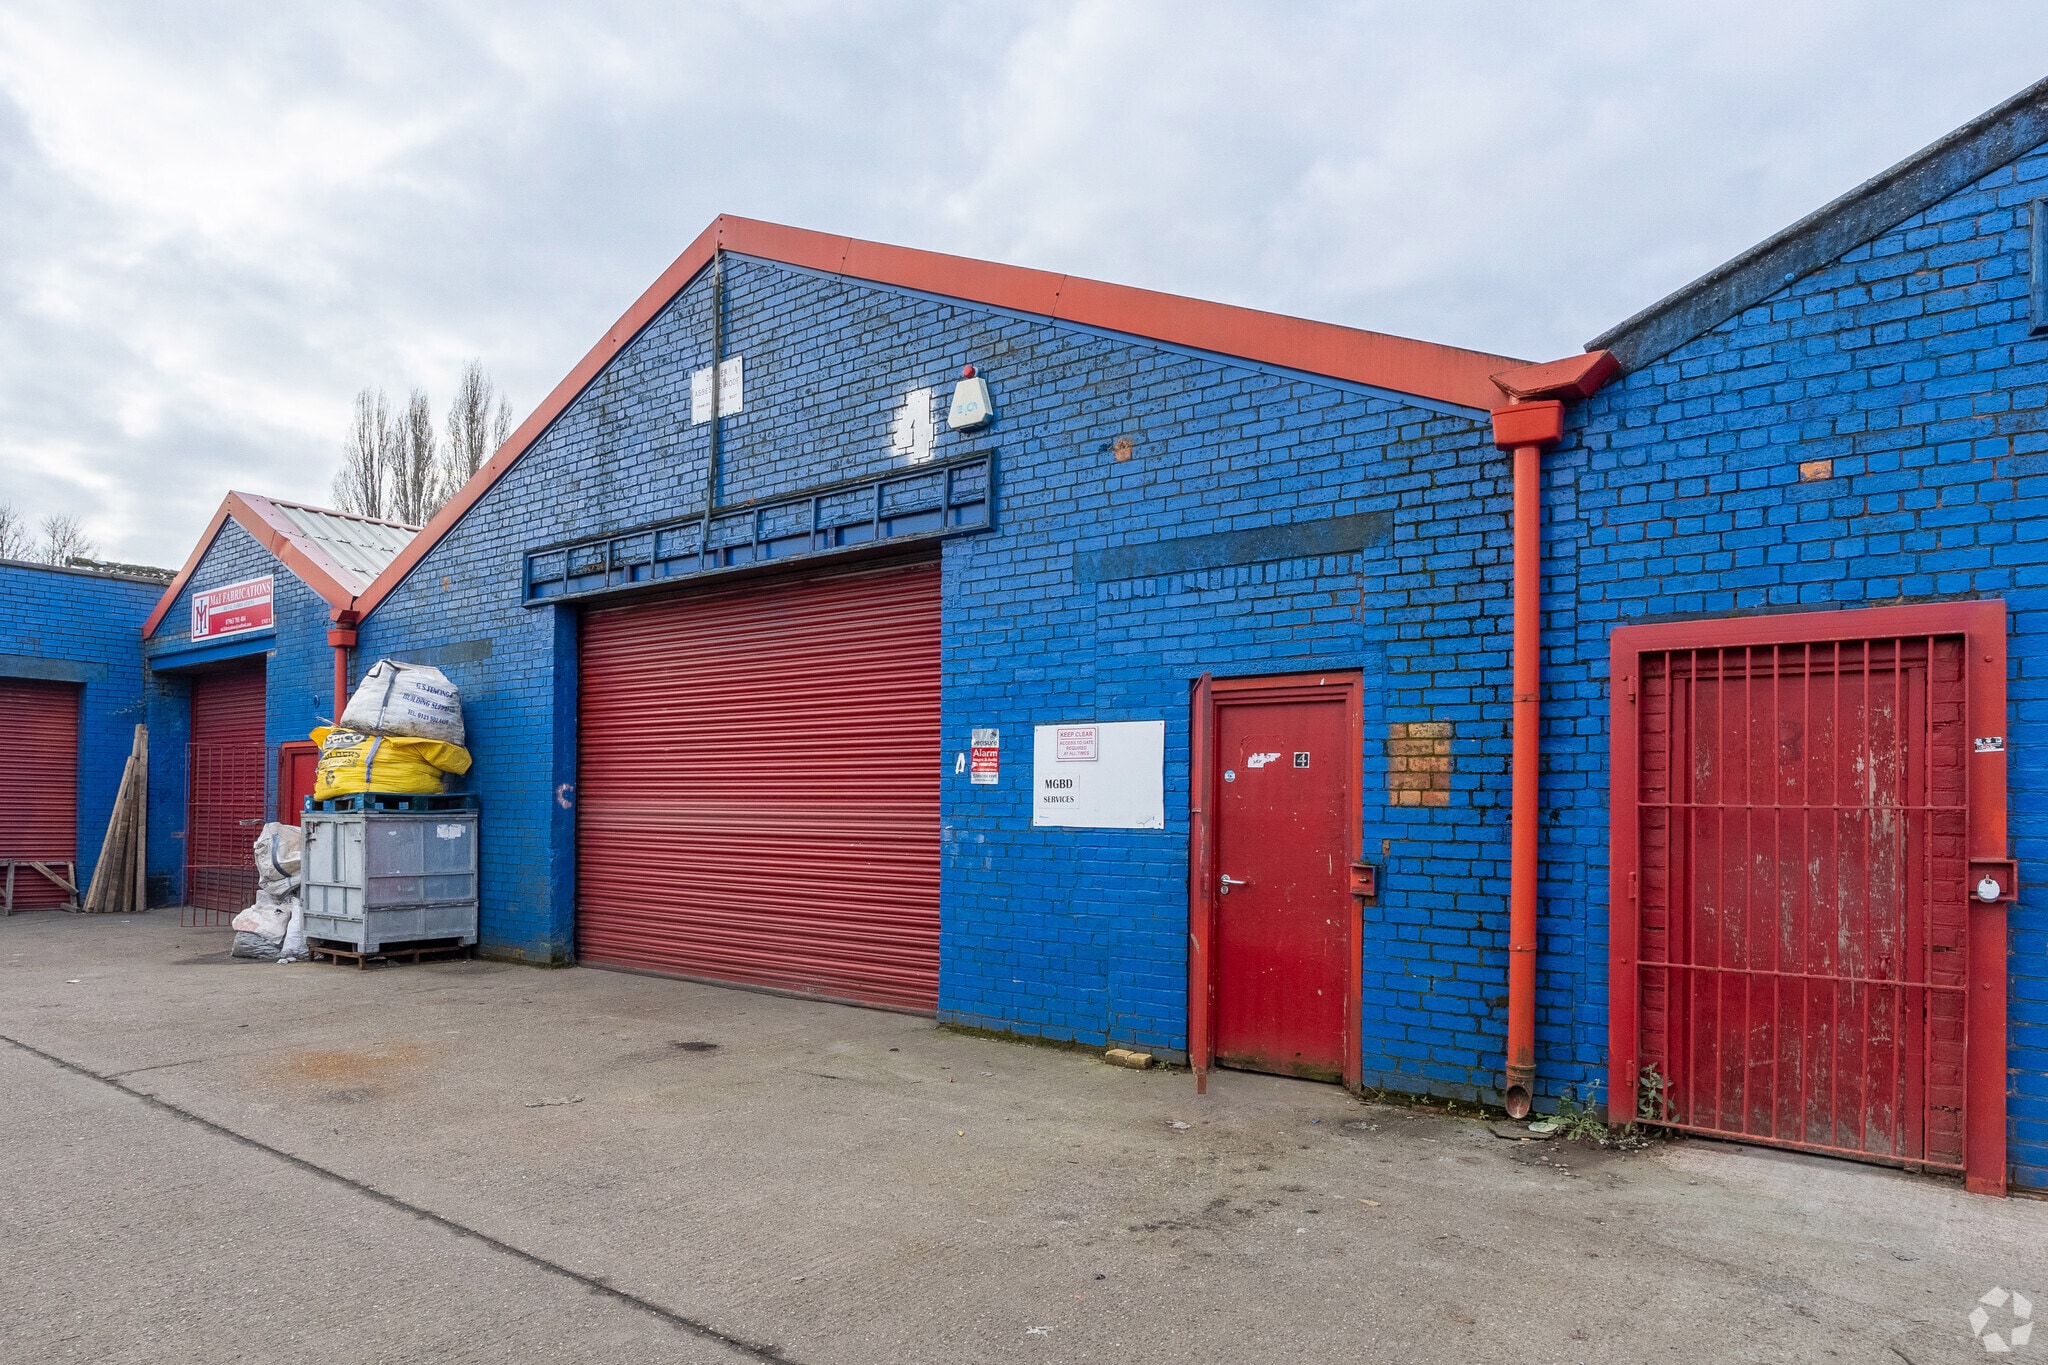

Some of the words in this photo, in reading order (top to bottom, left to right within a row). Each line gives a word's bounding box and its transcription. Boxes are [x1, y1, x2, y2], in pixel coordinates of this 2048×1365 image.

[890, 385, 933, 465] 4
[222, 582, 270, 603] FABRICATIONS
[402, 692, 430, 707] BUILDING
[418, 712, 429, 721] 0121
[973, 748, 998, 757] Alarm
[1297, 753, 1307, 767] 4
[1044, 779, 1073, 789] MGBD
[1043, 795, 1075, 803] SERVICES
